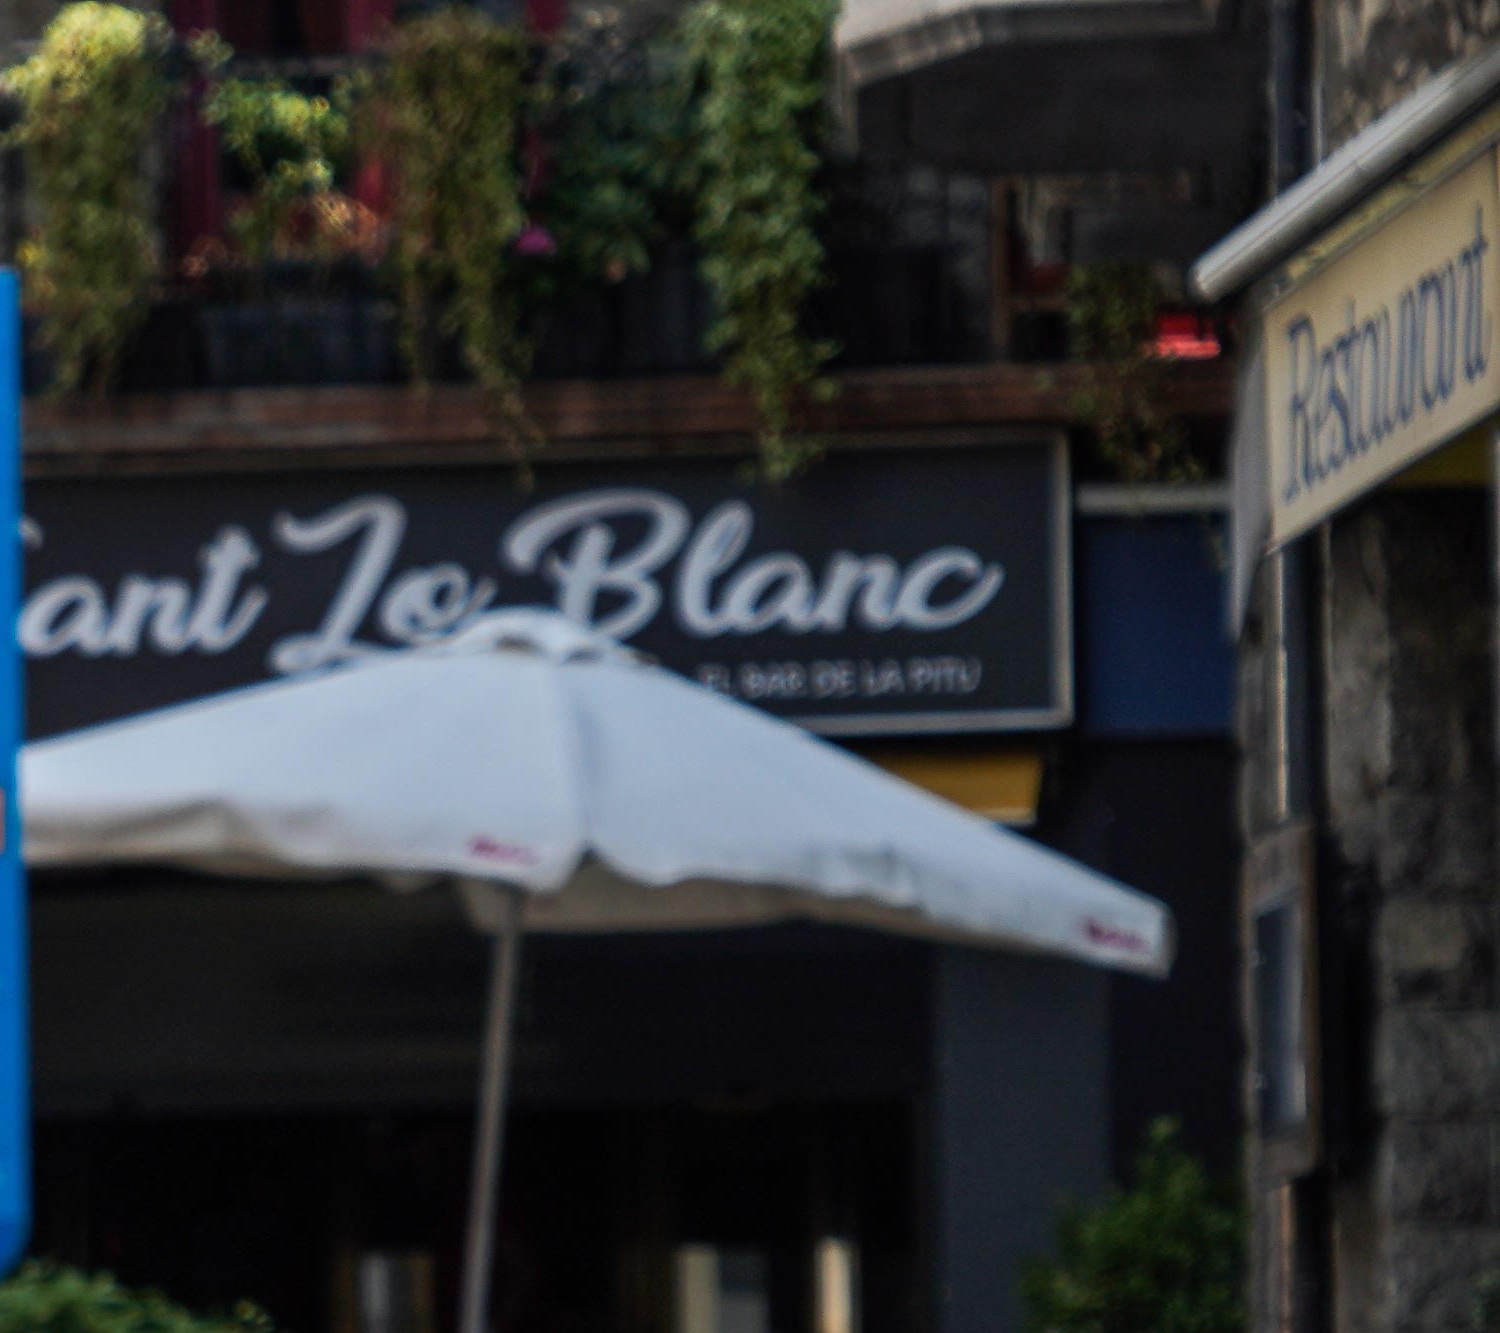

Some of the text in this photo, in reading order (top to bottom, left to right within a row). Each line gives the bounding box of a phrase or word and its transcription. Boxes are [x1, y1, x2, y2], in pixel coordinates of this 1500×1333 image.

[1284, 202, 1493, 505] Restaurant
[14, 524, 267, 658] ant
[502, 488, 1004, 642] Blanc
